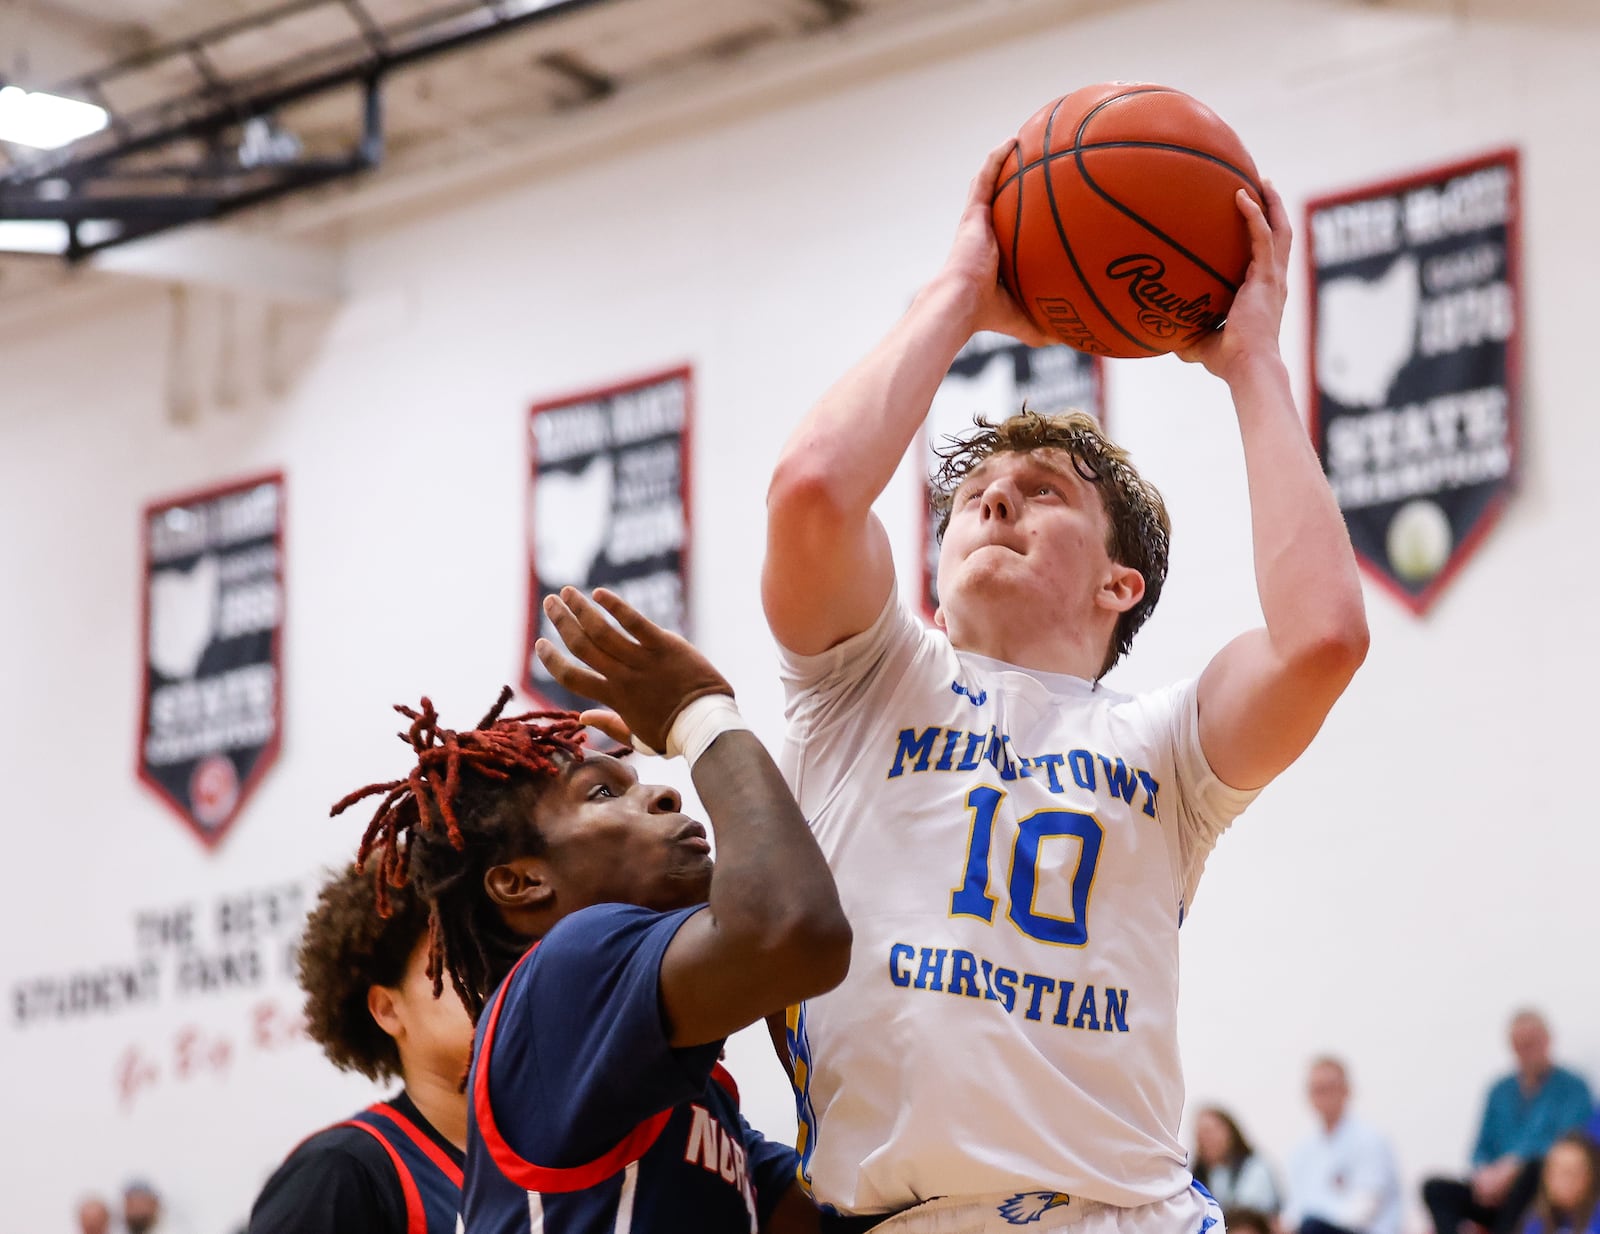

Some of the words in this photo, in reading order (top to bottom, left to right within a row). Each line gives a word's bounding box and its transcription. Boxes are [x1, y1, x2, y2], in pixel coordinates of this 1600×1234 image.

[1328, 386, 1509, 468] STATE
[948, 783, 1107, 949] 10
[134, 903, 194, 947] THE
[13, 960, 160, 1027] STUDENT
[889, 942, 1130, 1032] CHRISTIAN
